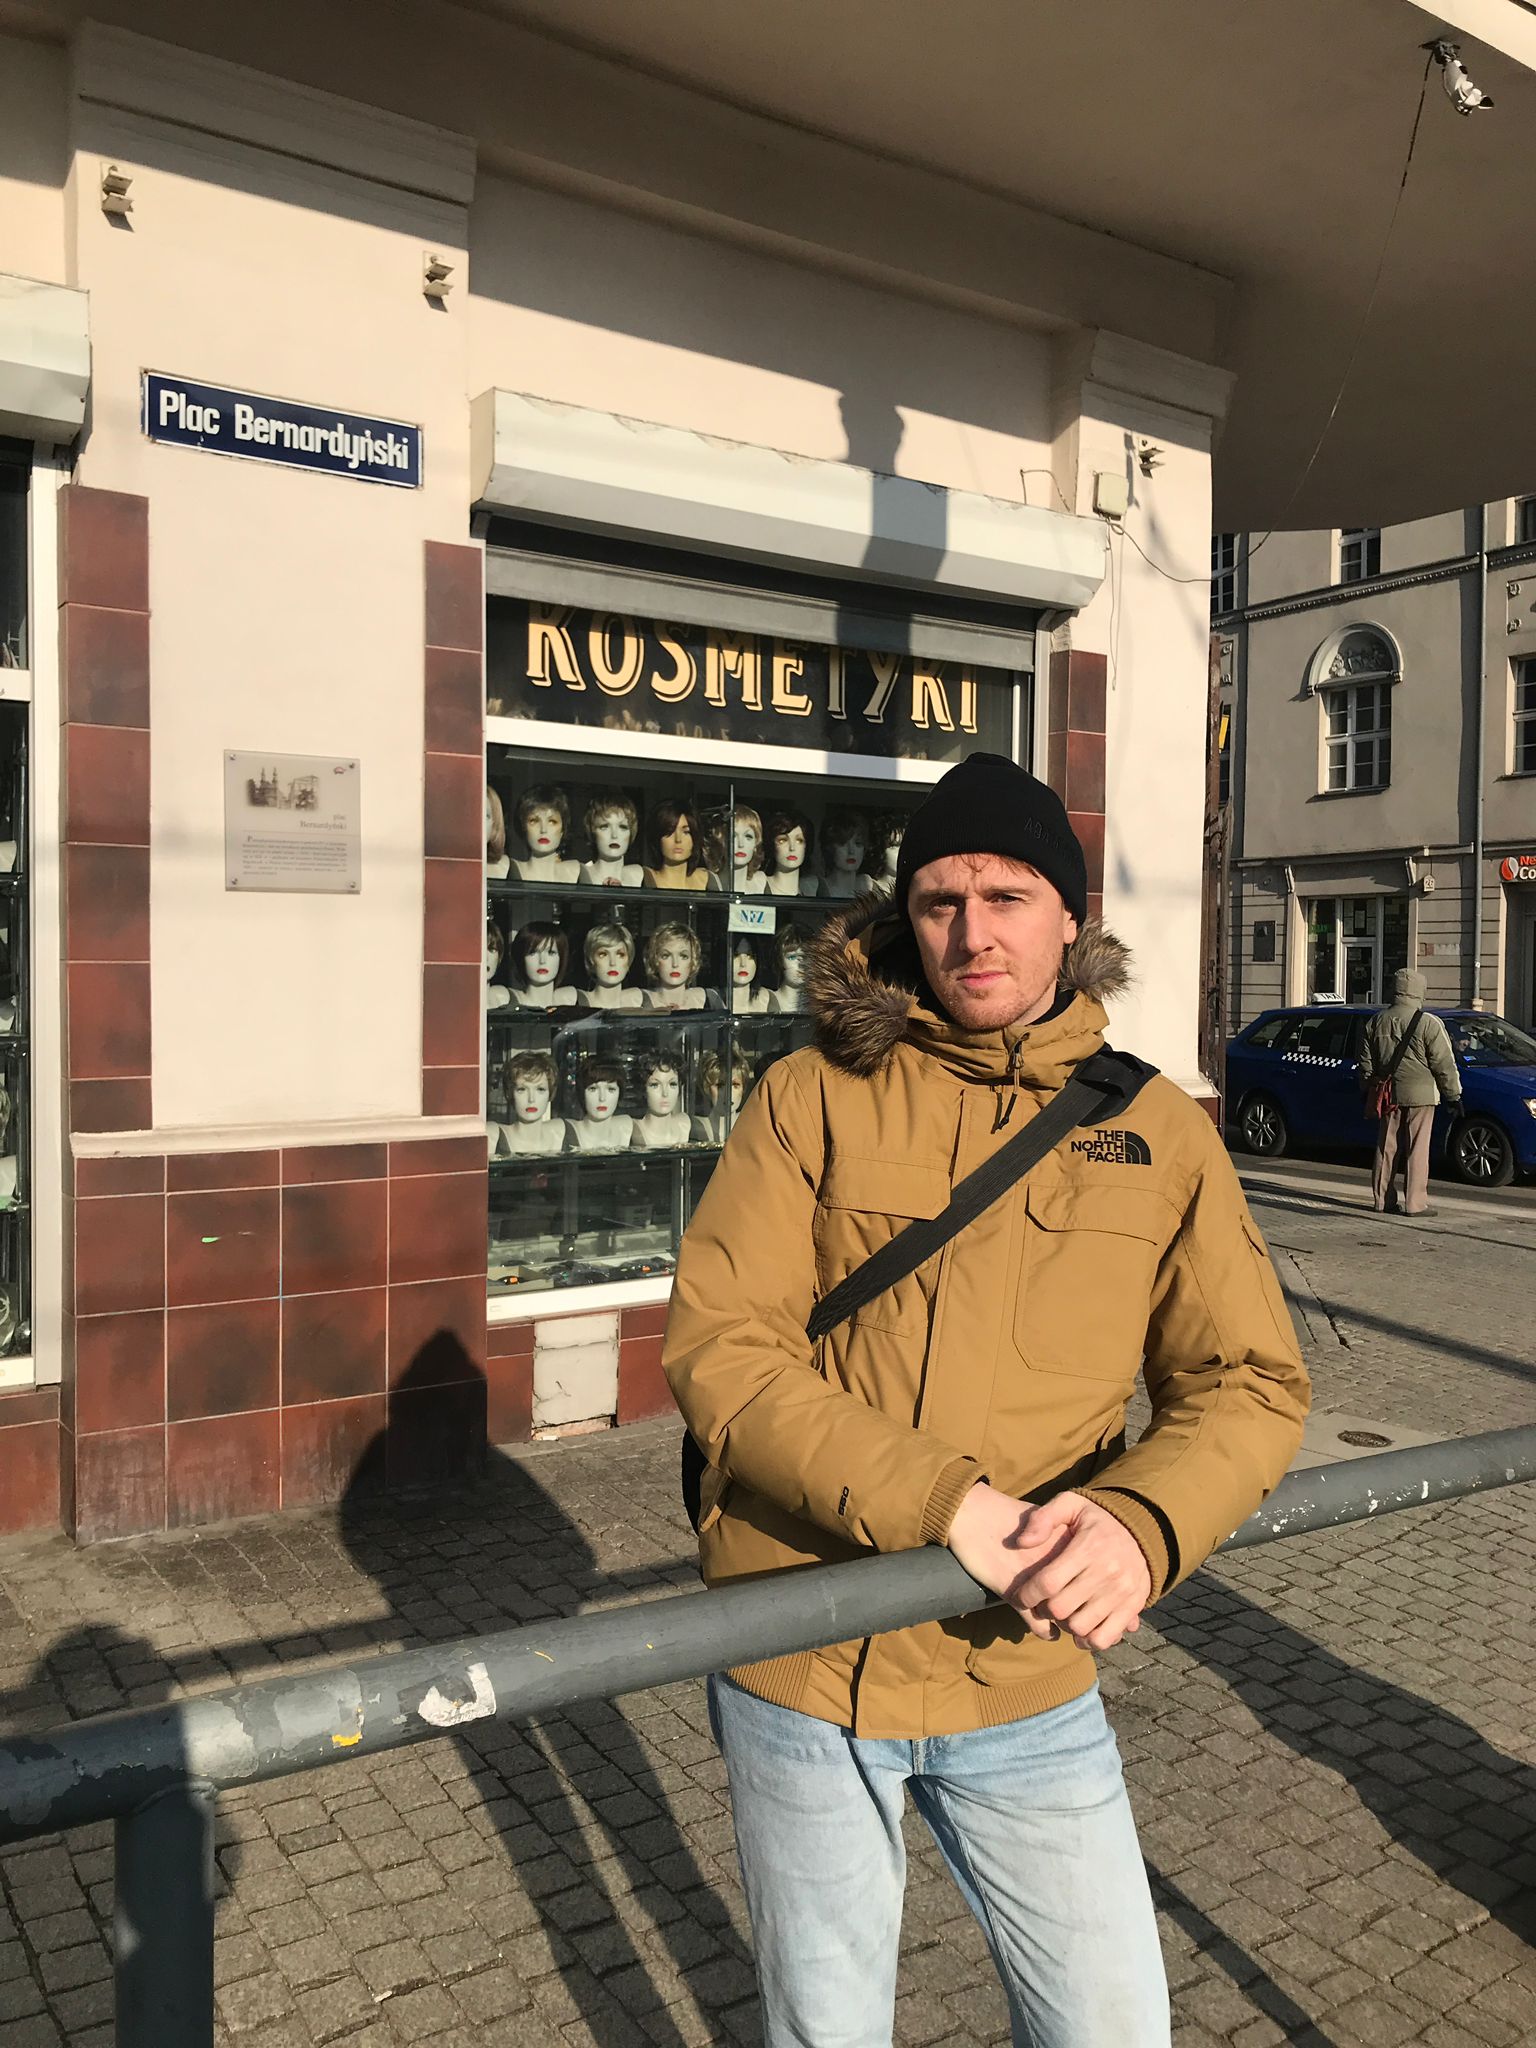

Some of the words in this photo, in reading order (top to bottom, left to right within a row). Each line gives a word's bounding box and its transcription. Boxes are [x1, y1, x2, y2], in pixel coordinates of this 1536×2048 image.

[159, 389, 220, 435] Plac
[234, 403, 409, 469] Bernardyński
[526, 602, 978, 734] KOSMETYKI
[740, 909, 765, 924] NFZ
[1094, 1129, 1124, 1141] THE
[1071, 1140, 1124, 1153] NORTH
[1086, 1152, 1125, 1164] FACE
